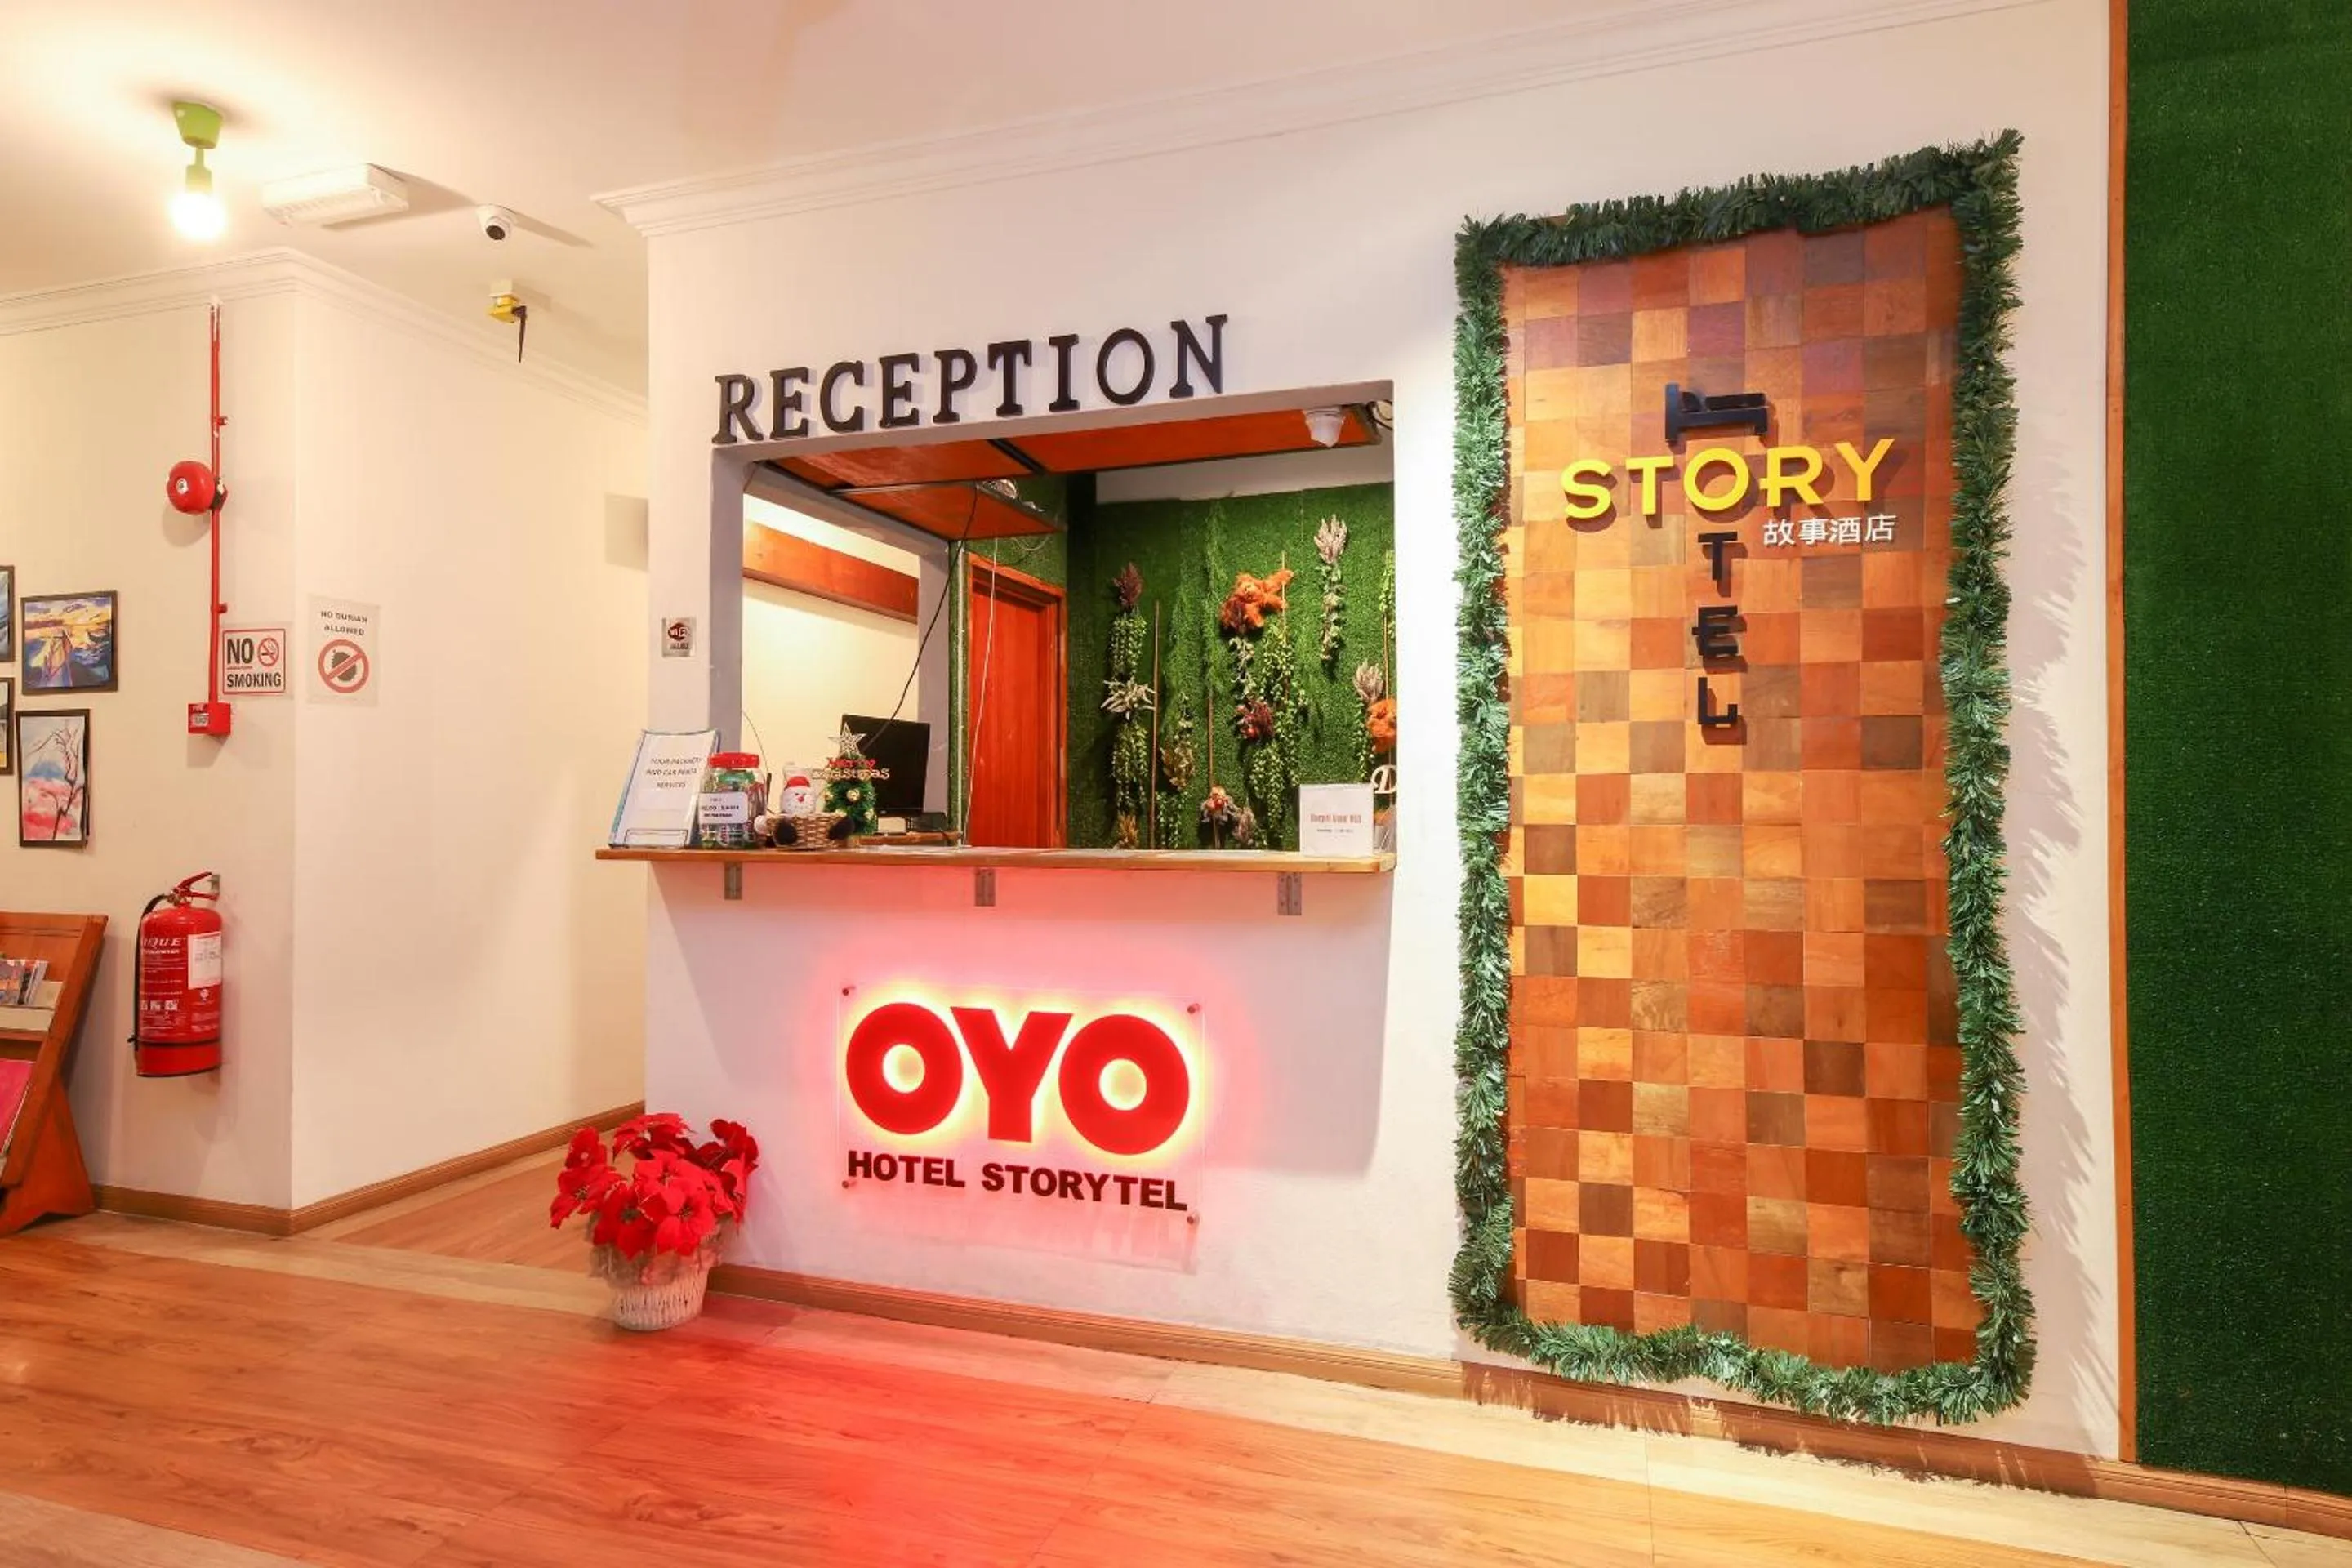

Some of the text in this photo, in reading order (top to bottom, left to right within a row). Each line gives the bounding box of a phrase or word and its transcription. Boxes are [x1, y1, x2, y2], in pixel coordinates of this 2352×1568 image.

[711, 314, 1227, 444] RECEPTION
[1561, 438, 1895, 519] STORY
[1762, 514, 1897, 546] 故事酒店
[320, 610, 333, 618] NO
[324, 624, 364, 635] ALLOWED
[227, 638, 254, 665] NO
[227, 672, 282, 688] SMOKING
[846, 1002, 1190, 1156] OYO
[848, 1150, 1188, 1211] HOTEL STORYTEL
